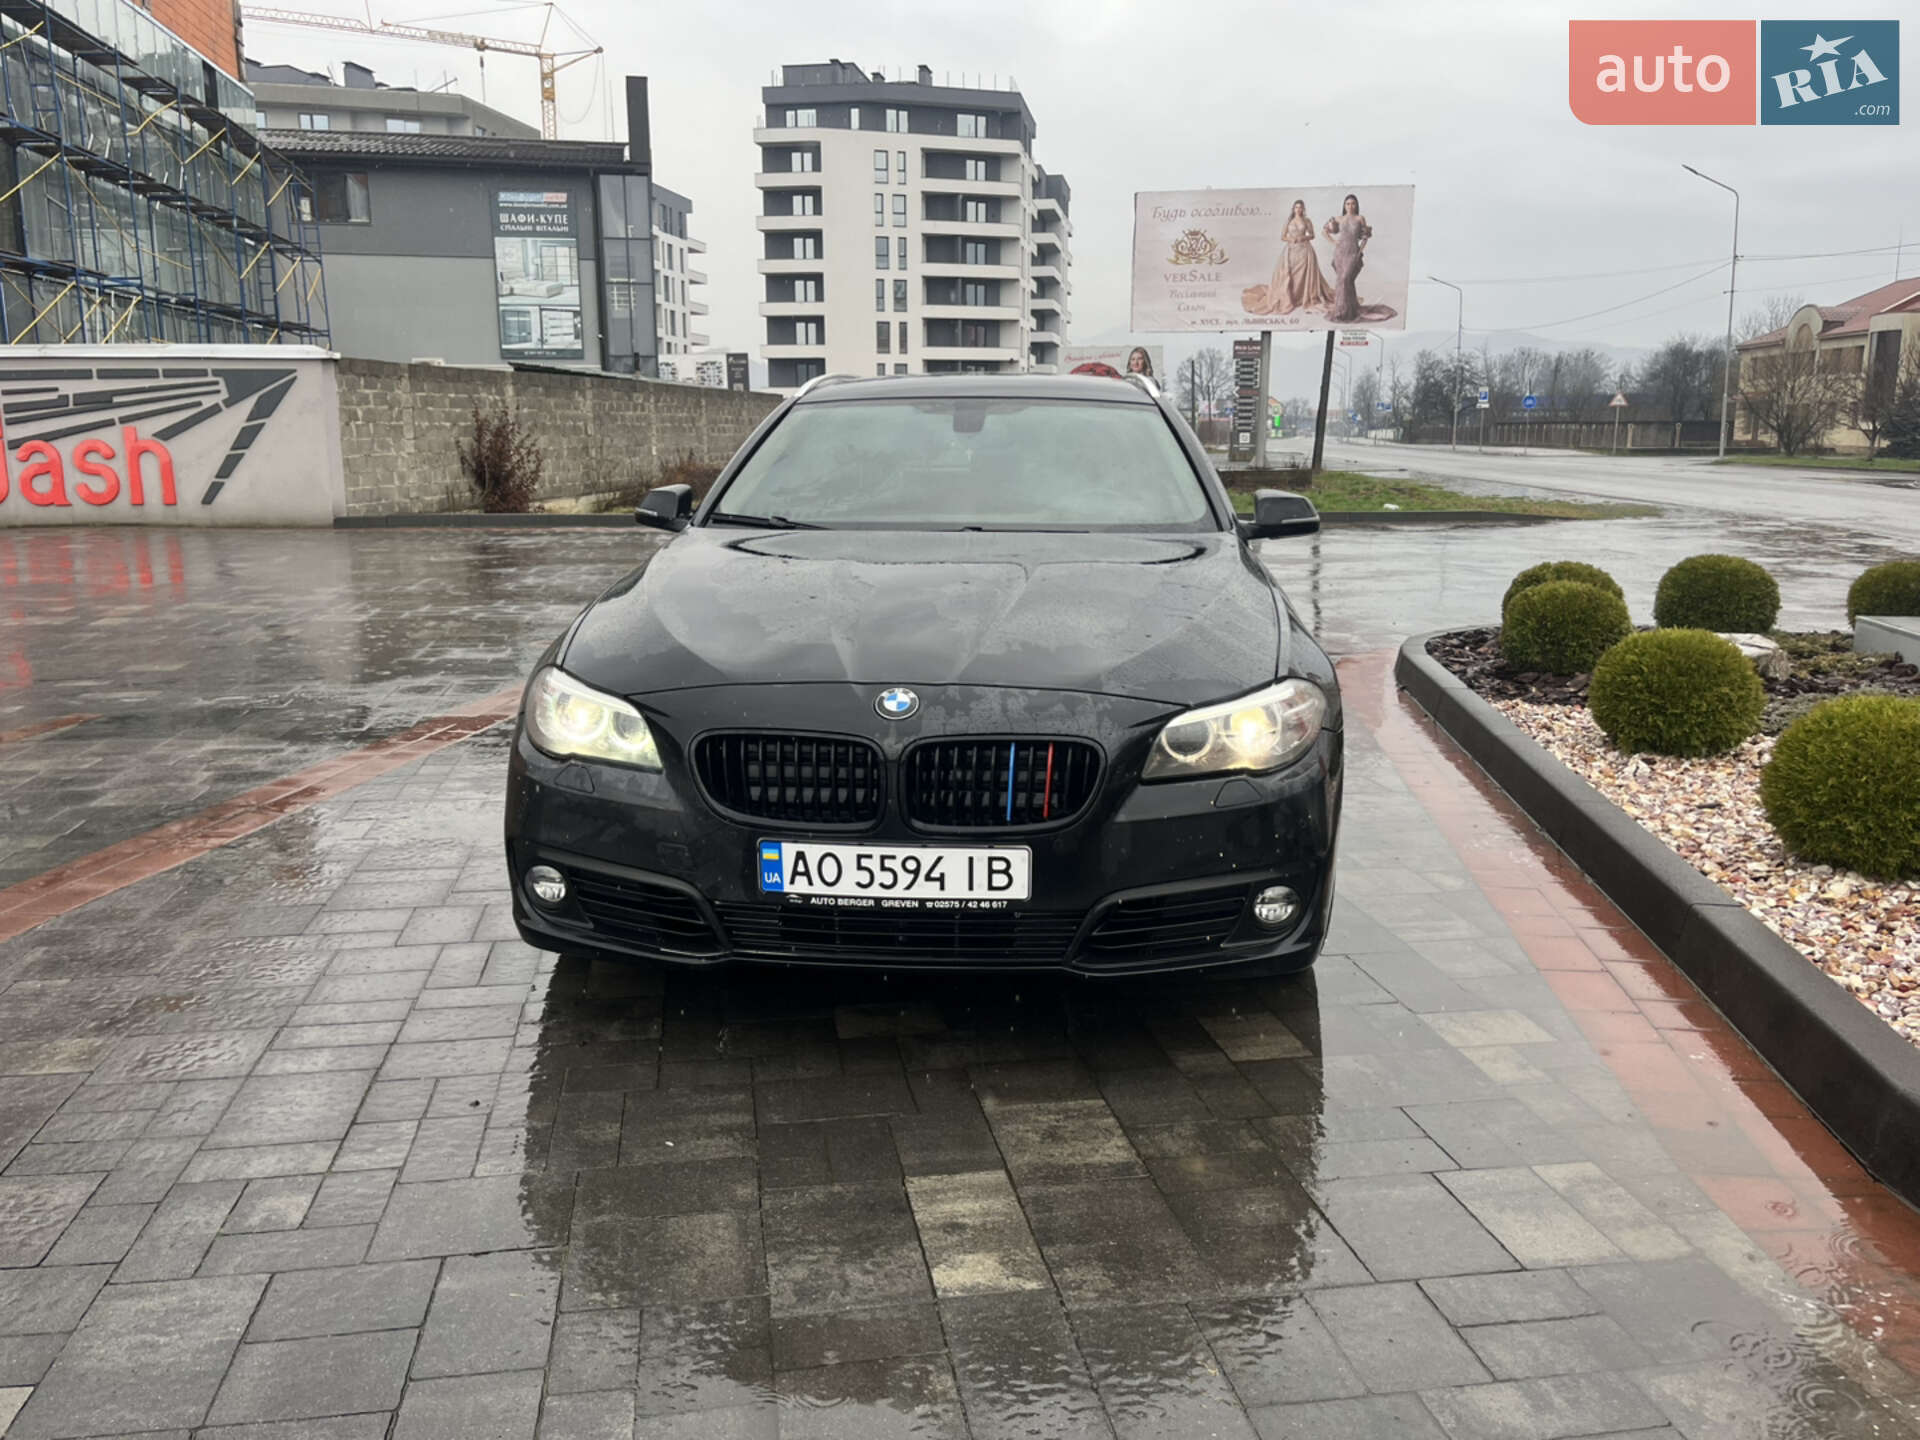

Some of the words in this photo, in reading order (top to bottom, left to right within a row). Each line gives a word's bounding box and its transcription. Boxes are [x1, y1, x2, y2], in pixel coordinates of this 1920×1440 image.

[1152, 206, 1186, 222] Будь
[0, 425, 177, 506] ash
[764, 872, 782, 884] UA
[789, 850, 843, 887] AO
[855, 853, 946, 892] 5594
[967, 855, 1014, 892] IB
[810, 897, 836, 905] AUTO
[837, 898, 875, 907] BERGER
[881, 899, 919, 908] GREVEN
